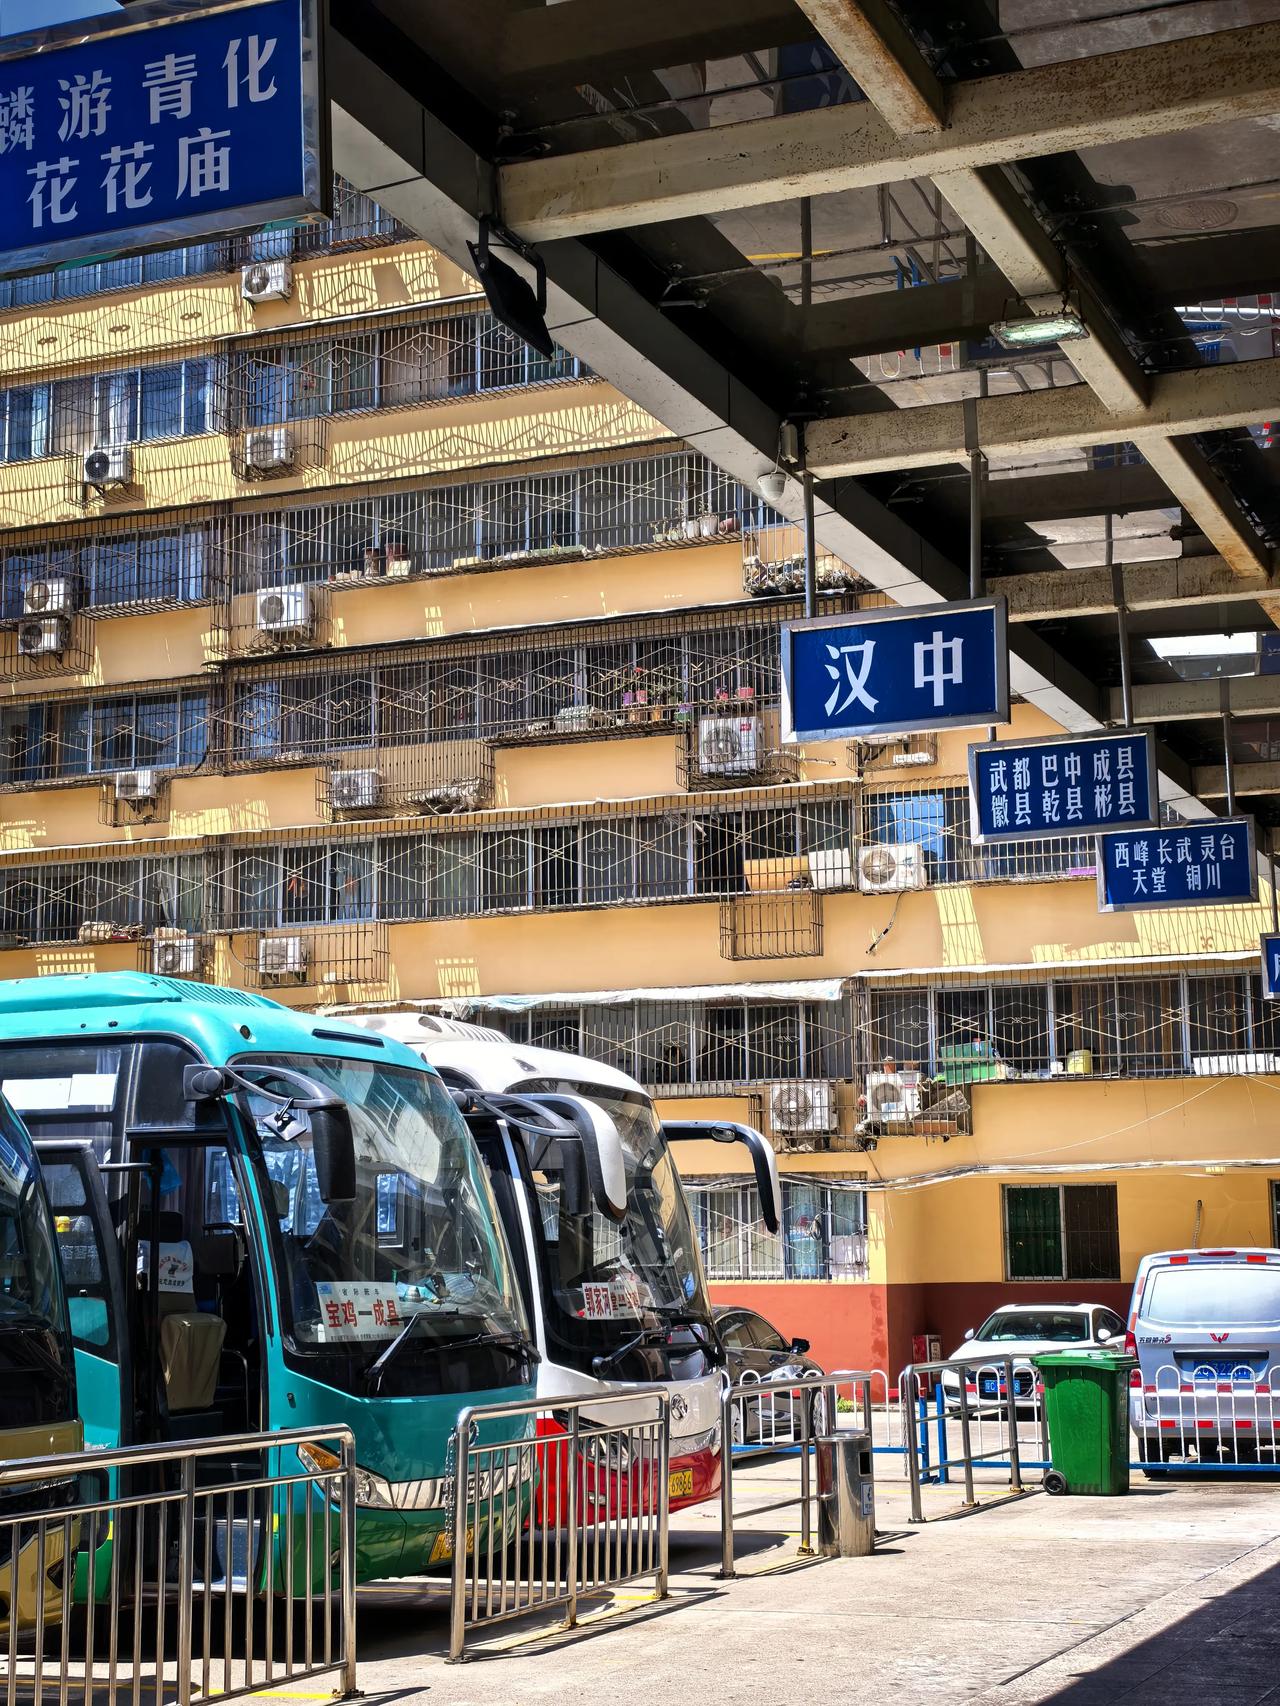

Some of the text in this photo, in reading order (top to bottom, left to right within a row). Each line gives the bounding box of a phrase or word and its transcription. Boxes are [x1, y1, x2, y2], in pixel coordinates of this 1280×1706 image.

[26, 127, 231, 229] 花花庙
[824, 630, 965, 717] 汉中
[989, 746, 1134, 793] 武都 巴中 成县
[991, 781, 1136, 828] 徽县 乾县 彬县
[1114, 833, 1235, 868] 西峰 长武 灵台
[1132, 862, 1221, 895] 天堂 铜川
